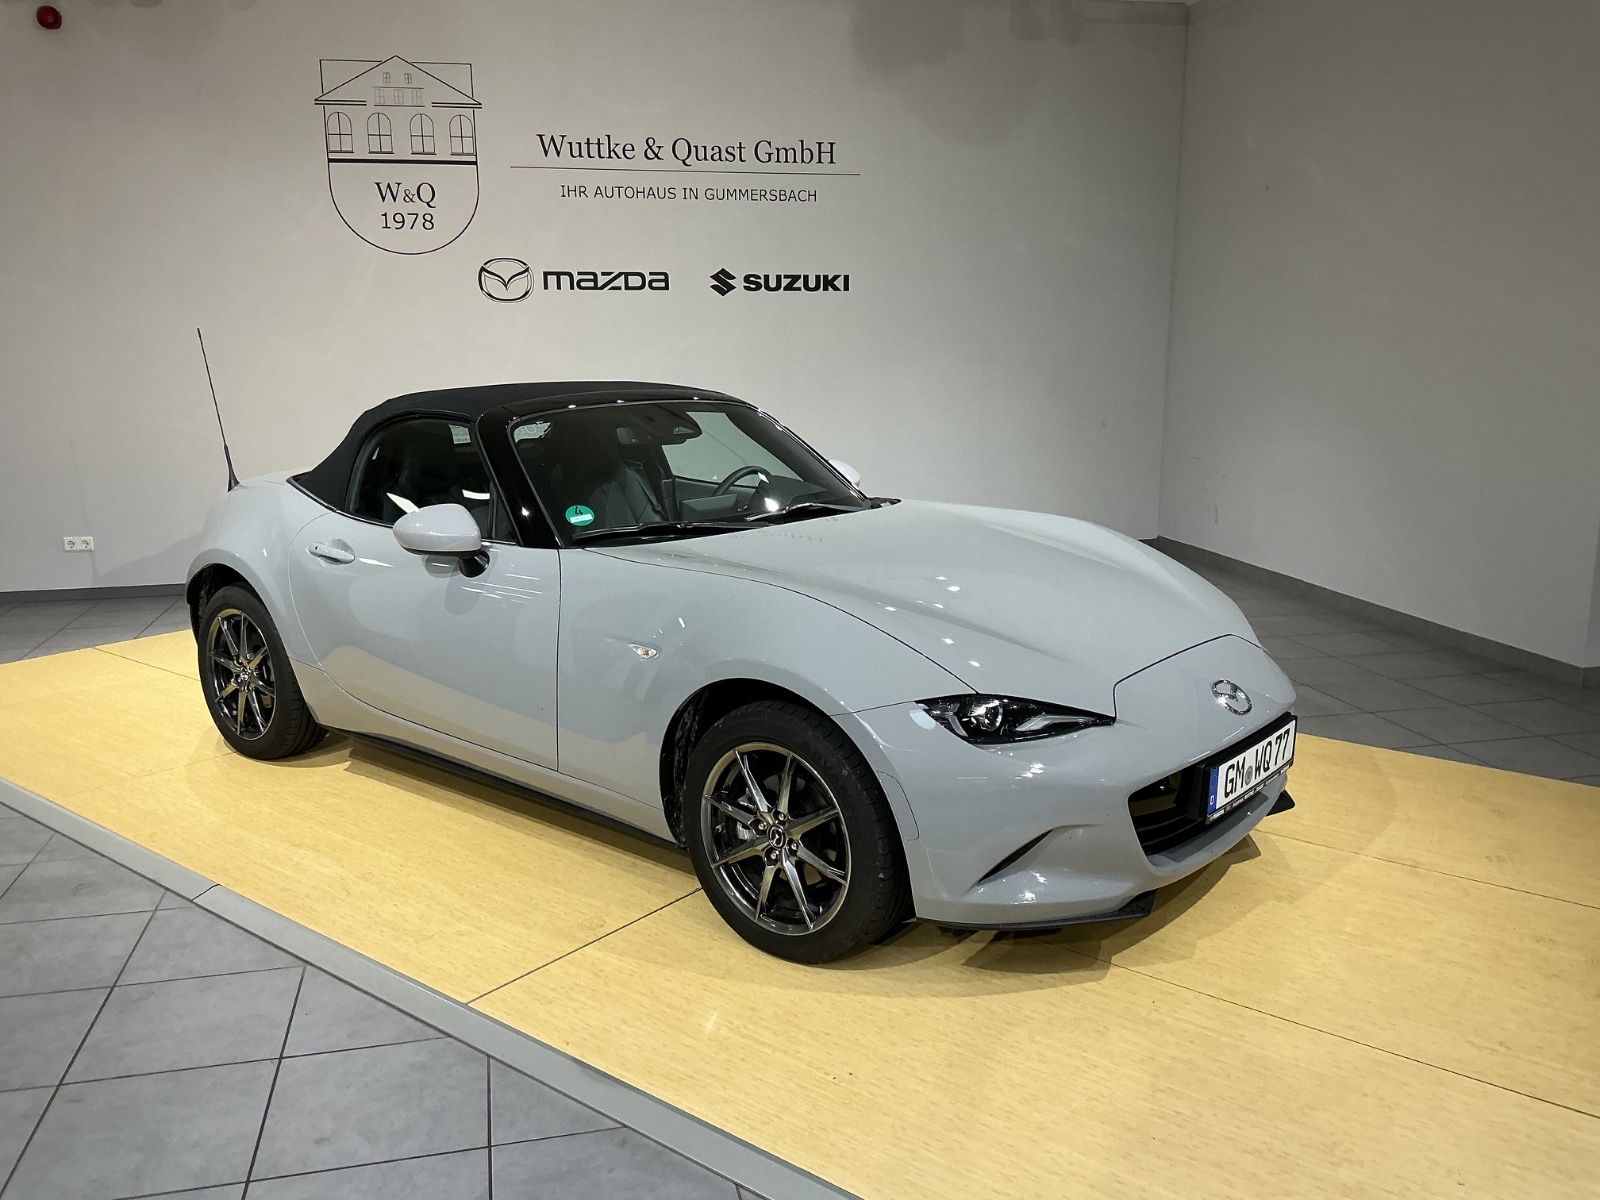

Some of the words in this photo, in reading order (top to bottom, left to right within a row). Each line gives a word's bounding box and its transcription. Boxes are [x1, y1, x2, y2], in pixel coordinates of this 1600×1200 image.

[536, 133, 636, 161] Wuttke
[643, 136, 665, 161] &
[671, 137, 747, 167] Quast
[753, 139, 837, 165] GmbH
[374, 181, 437, 208] W&Q
[560, 184, 589, 199] IHR
[593, 185, 677, 200] AUTOHAUS
[682, 187, 699, 200] IN
[704, 188, 818, 203] GUMMERSBACH
[380, 211, 435, 231] 1978
[742, 273, 850, 293] SUZUKI
[574, 505, 583, 516] 4
[1224, 755, 1246, 799] GM
[1254, 740, 1273, 780] WQ
[1275, 727, 1291, 766] 77
